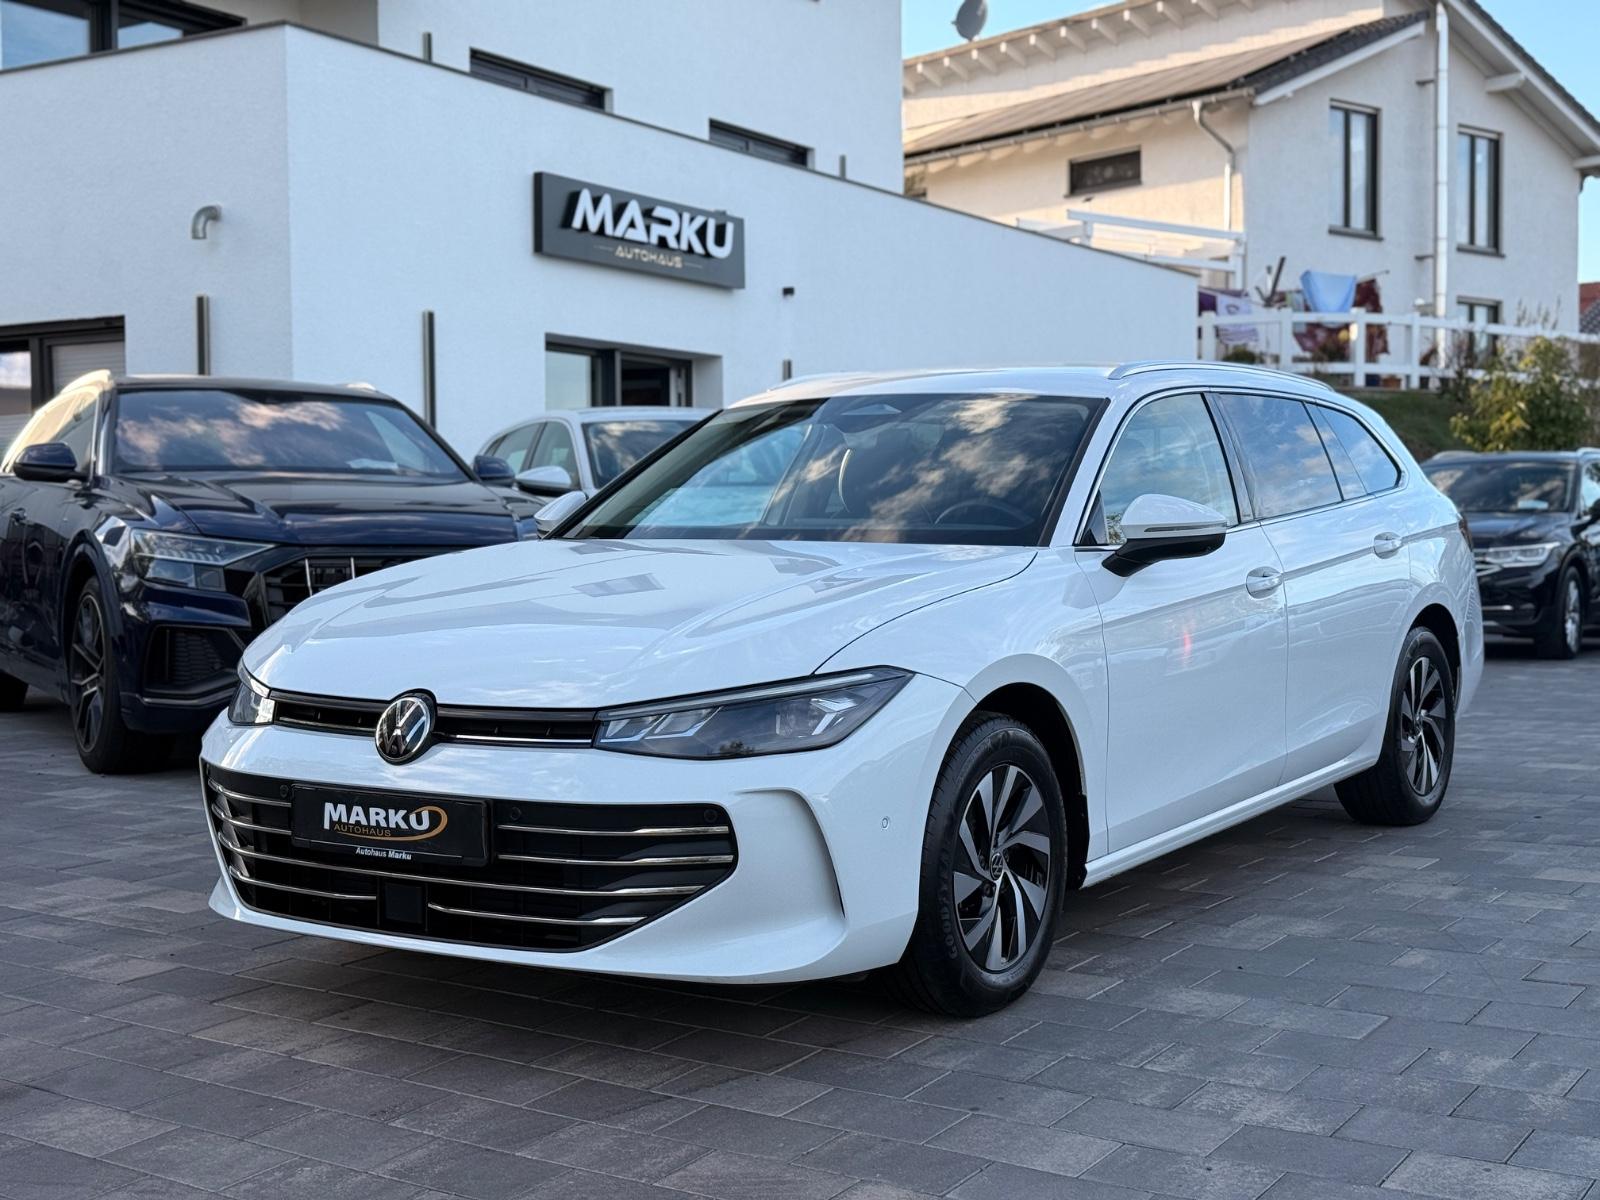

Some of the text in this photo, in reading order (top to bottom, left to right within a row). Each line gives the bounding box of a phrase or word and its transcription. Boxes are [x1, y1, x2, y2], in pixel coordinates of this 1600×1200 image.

[571, 188, 734, 258] MARKU
[615, 246, 683, 268] AUTOHAUS
[323, 802, 430, 830] MARKU
[333, 823, 392, 837] AUTOHAUS
[355, 847, 412, 861] Autohaus Marku
